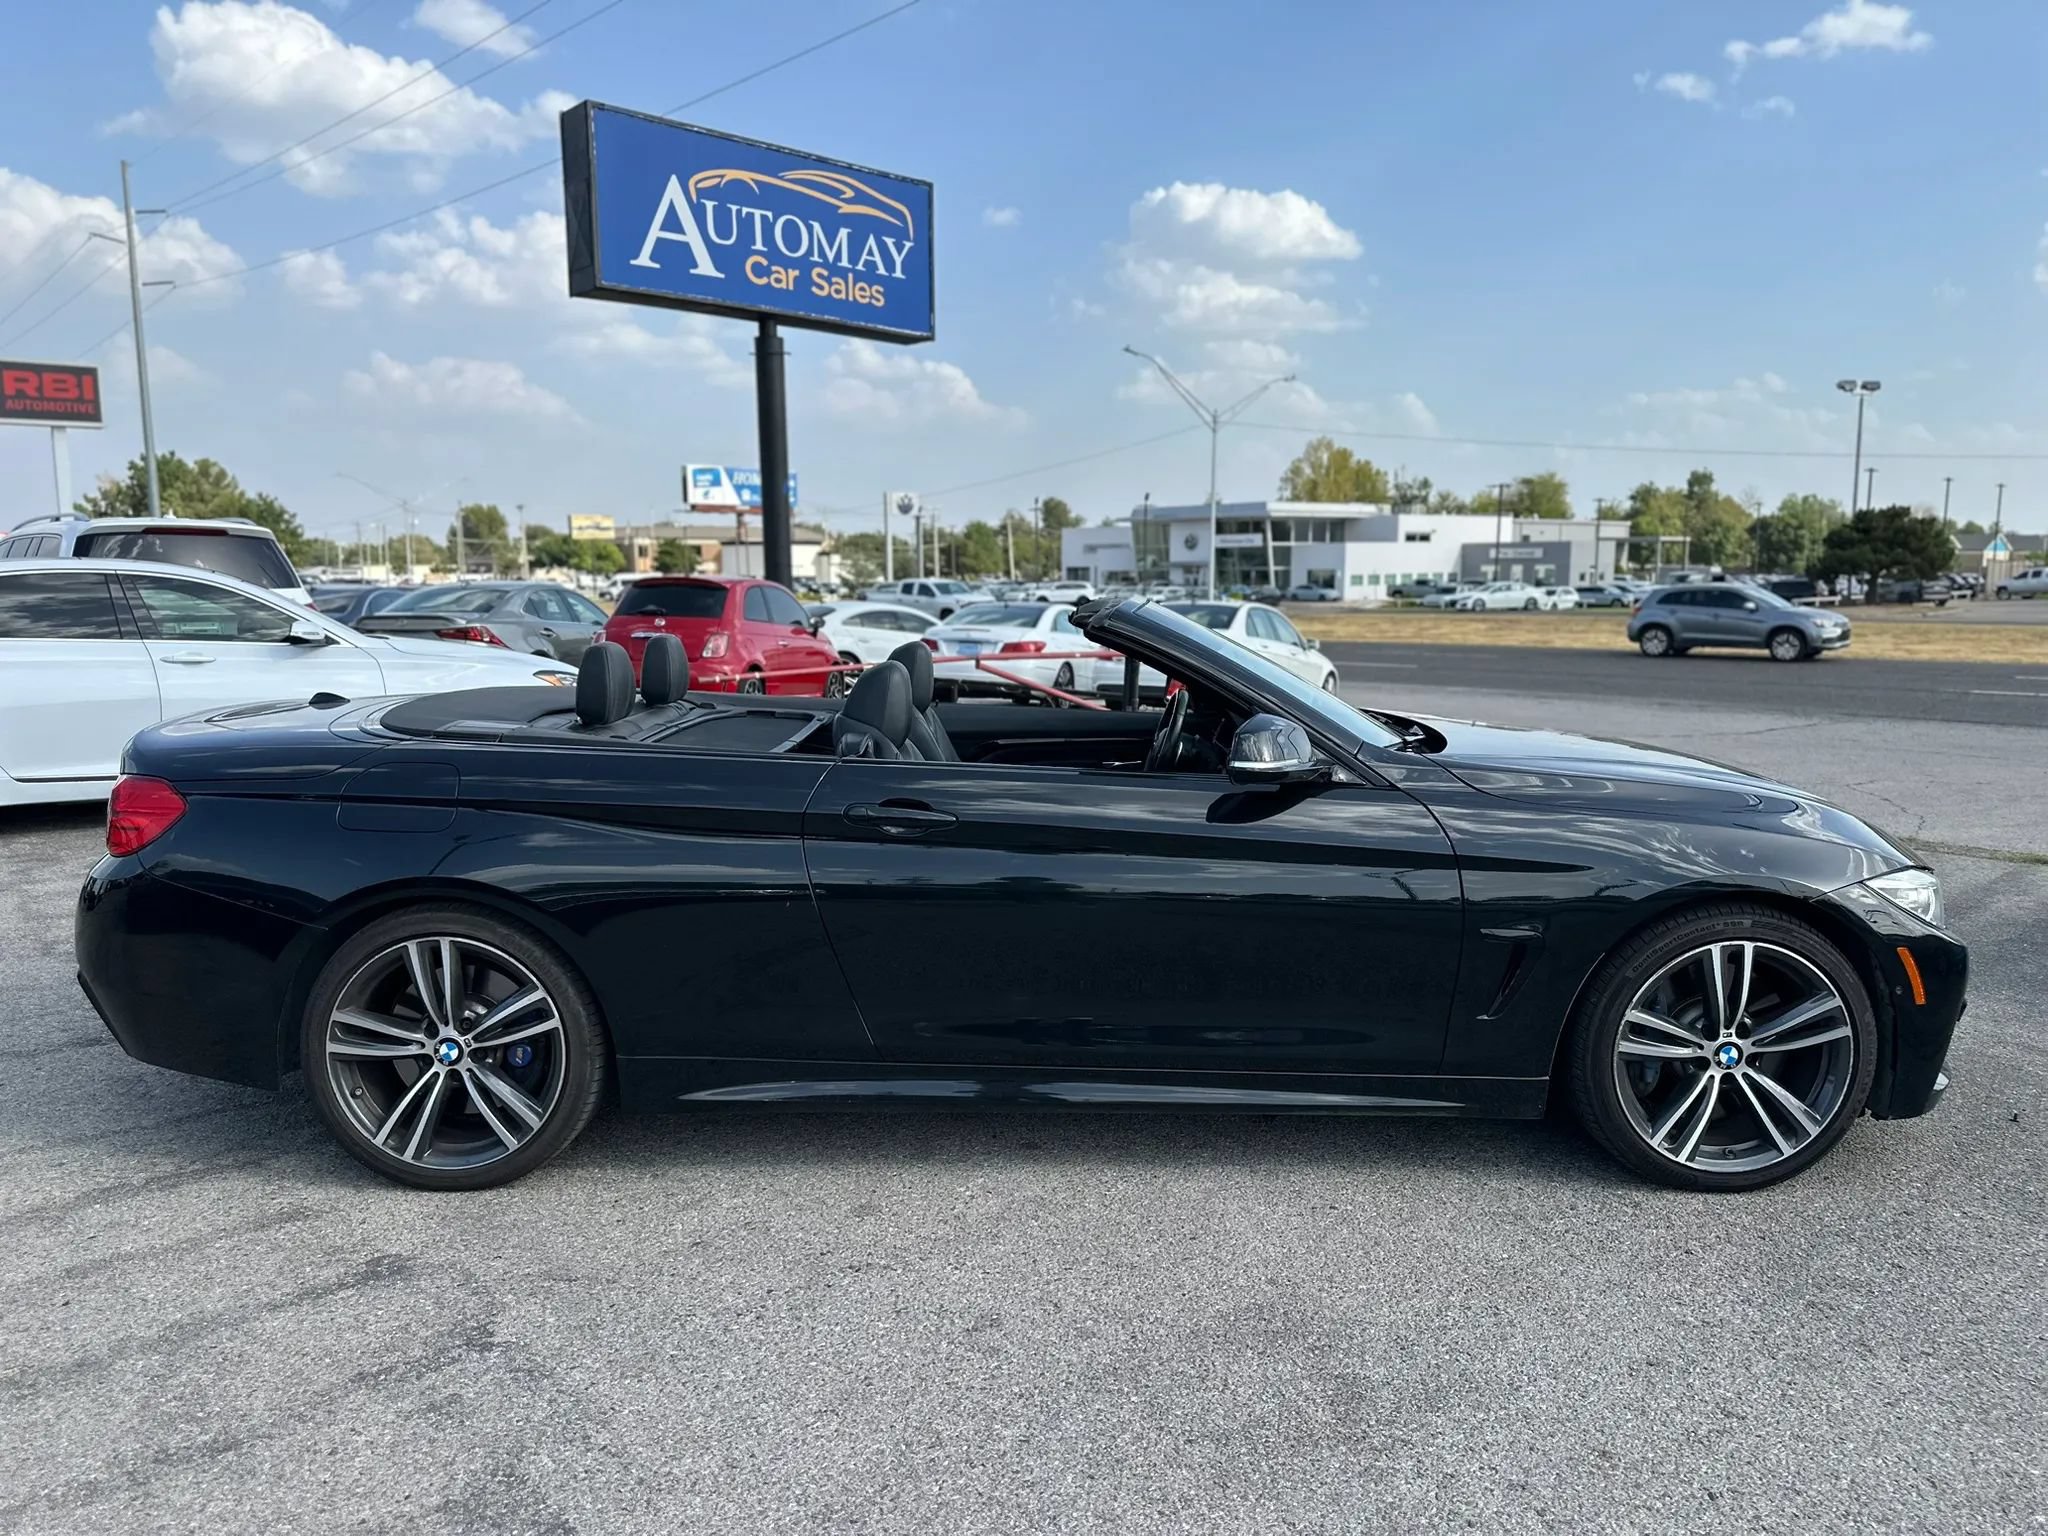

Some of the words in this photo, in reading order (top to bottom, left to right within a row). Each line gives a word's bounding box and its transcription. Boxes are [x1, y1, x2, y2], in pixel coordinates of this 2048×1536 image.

[630, 173, 915, 280] AUTOMAY
[745, 255, 800, 291] Car
[811, 267, 885, 308] Sales
[3, 369, 95, 401] RBI
[5, 399, 97, 415] AUTOMOTIVE
